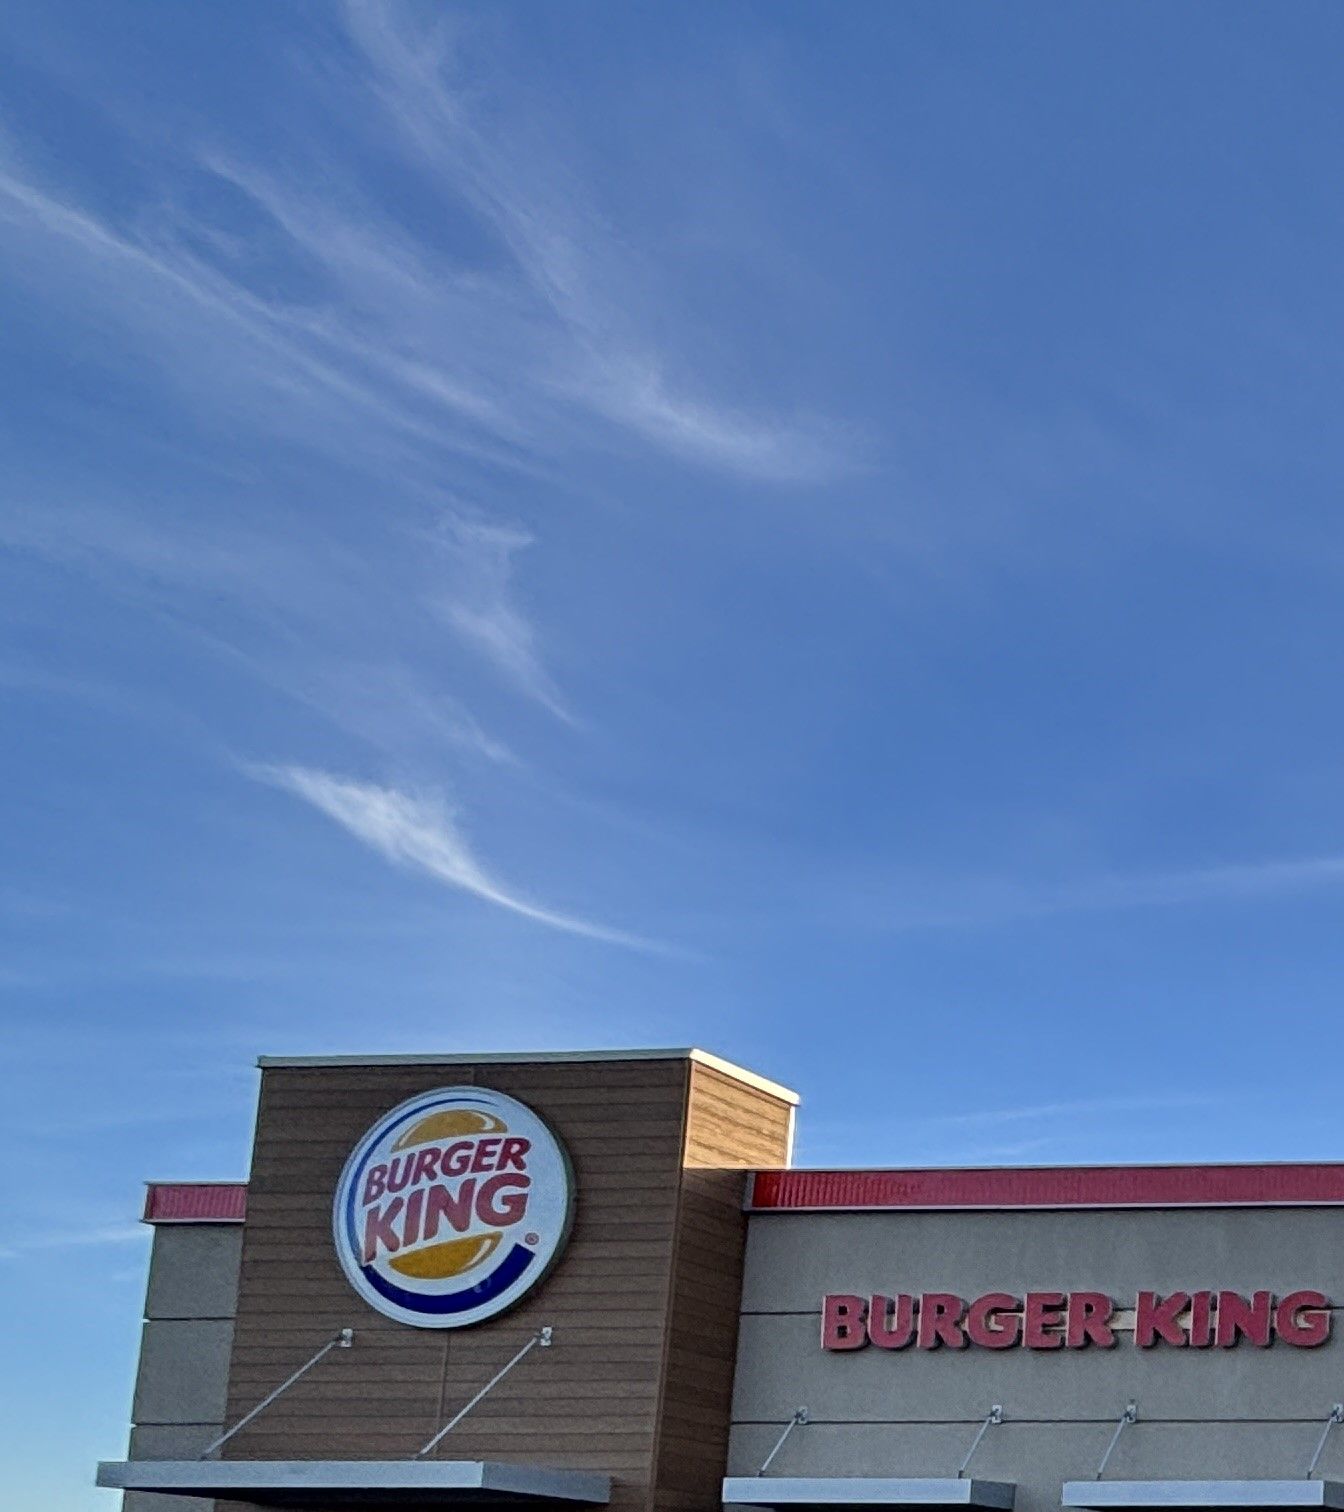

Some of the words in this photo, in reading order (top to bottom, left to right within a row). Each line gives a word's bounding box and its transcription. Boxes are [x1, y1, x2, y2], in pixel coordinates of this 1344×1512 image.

[363, 1137, 532, 1207] BURGER
[363, 1172, 532, 1264] KING
[821, 1291, 1118, 1350] BURGER
[1133, 1290, 1333, 1349] KING
